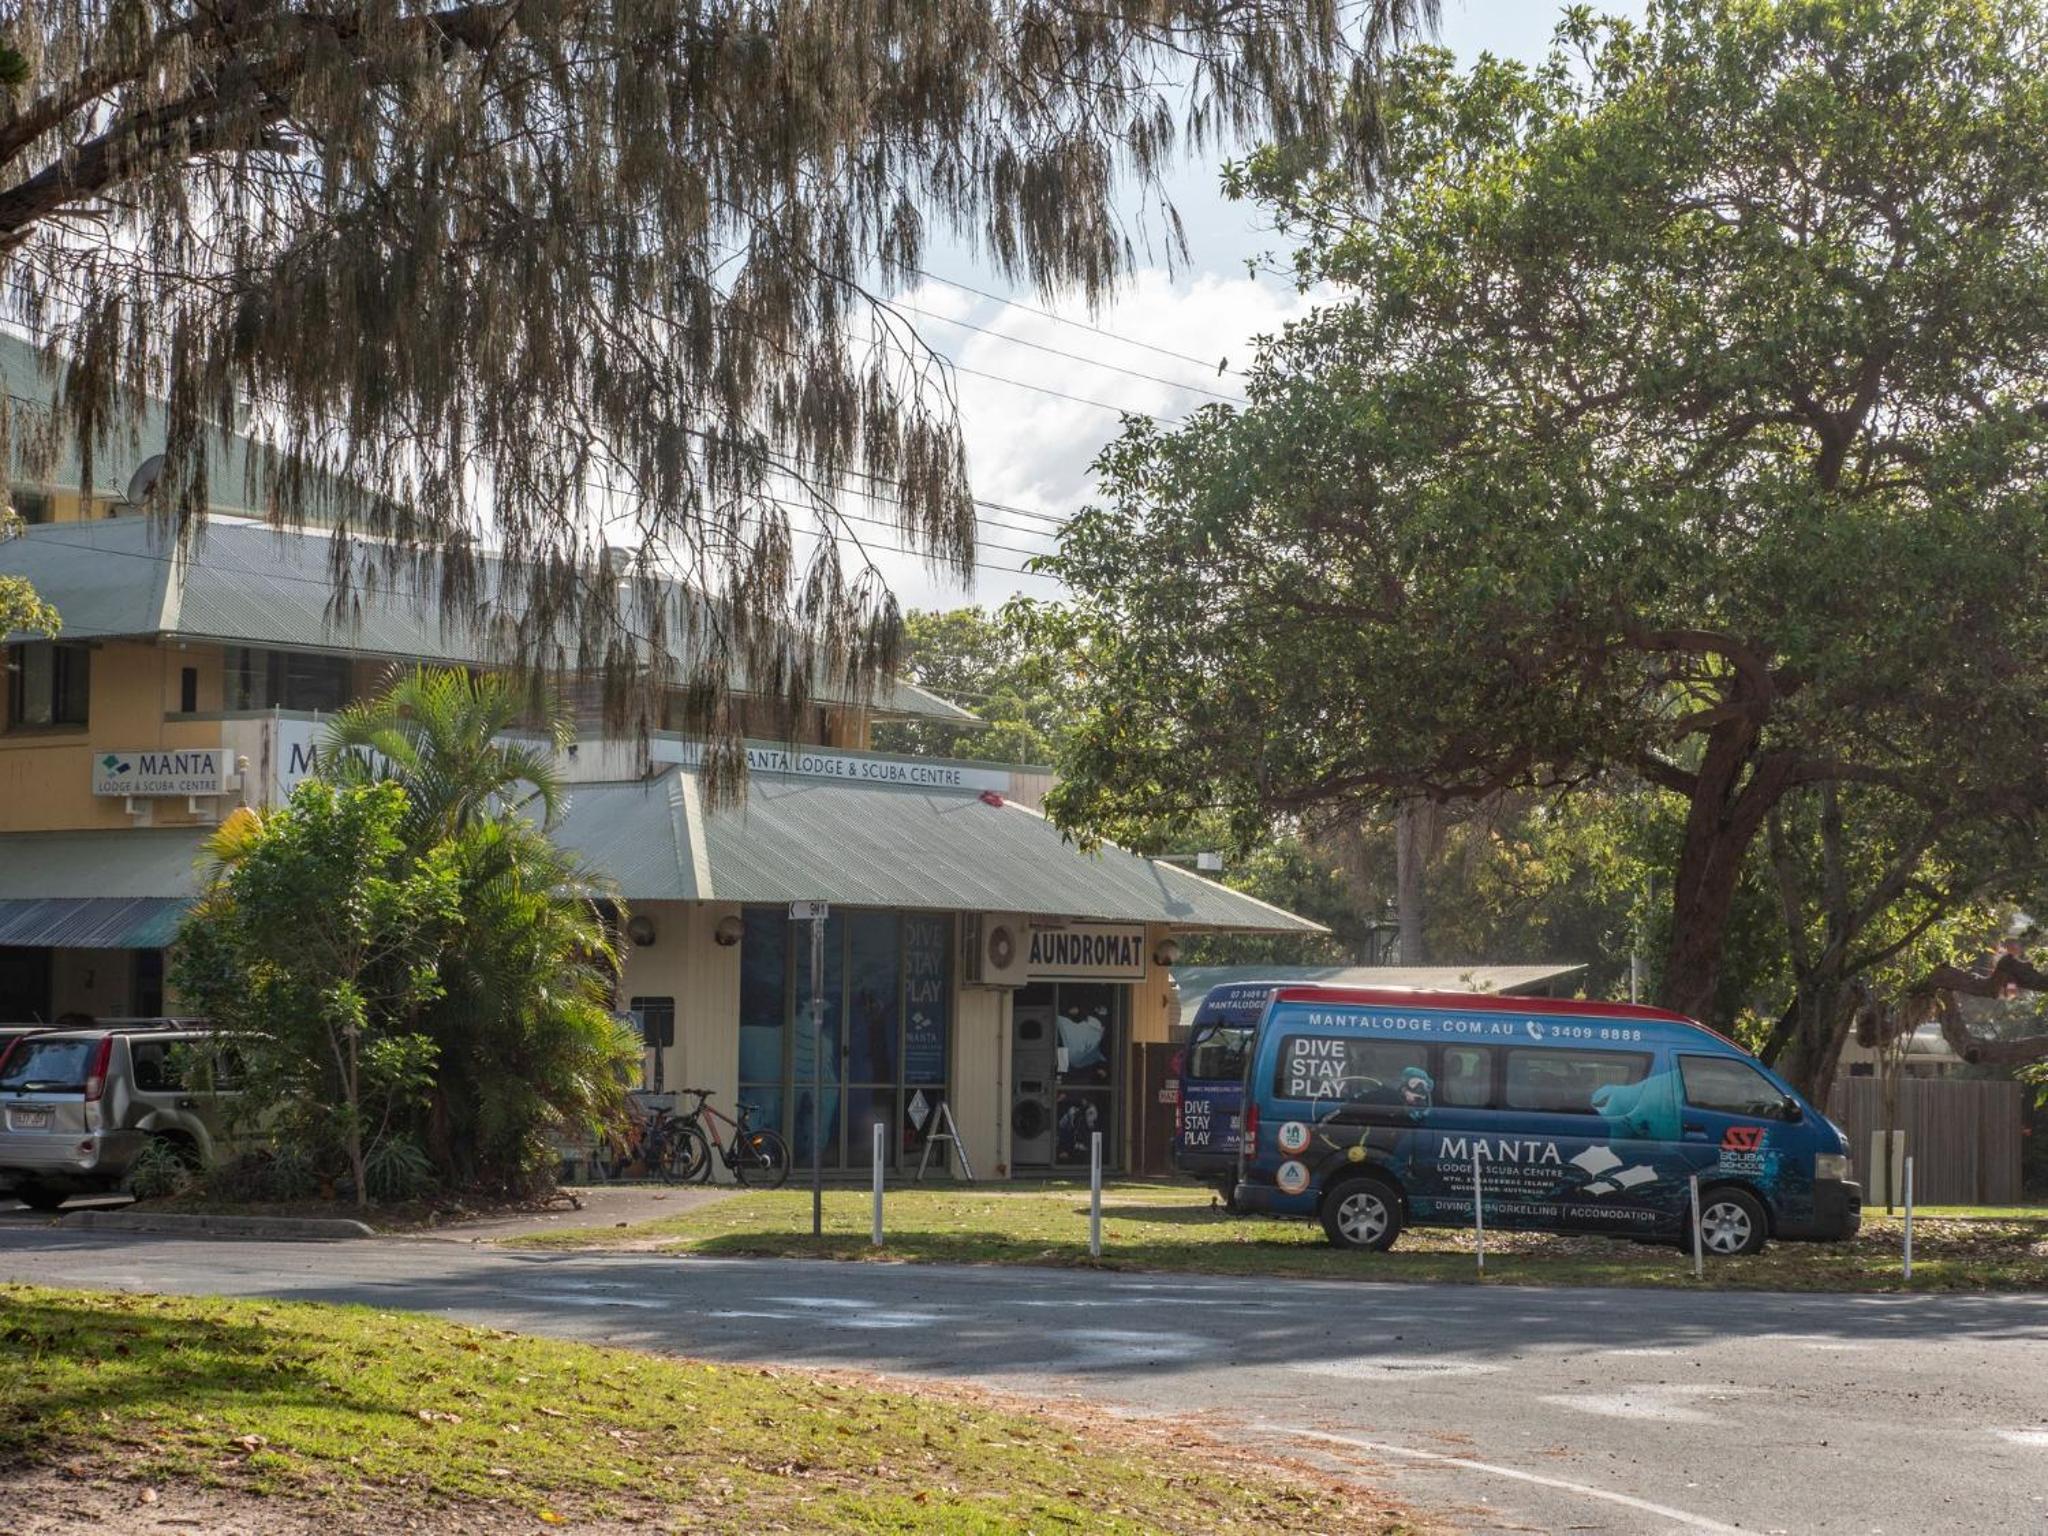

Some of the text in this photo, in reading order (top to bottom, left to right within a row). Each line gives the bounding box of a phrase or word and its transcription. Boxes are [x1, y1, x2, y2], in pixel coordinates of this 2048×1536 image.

[139, 753, 216, 775] MANTA
[748, 751, 961, 785] ANTA LODGE & SCUBA CENTRE
[98, 780, 131, 793] LODGE
[143, 780, 175, 792] SCUBA
[179, 780, 217, 791] CENTRE
[1029, 932, 1143, 967] AUNDROMAT
[905, 979, 942, 1003] PLAY
[1208, 1000, 1267, 1010] MANTALODGE
[1309, 1013, 1642, 1042] MANTALODGE.COM.AU 3409 8888
[1295, 1039, 1345, 1058] DIVE
[1292, 1059, 1347, 1079] STAY
[1290, 1079, 1347, 1099] PLAY
[1184, 1100, 1211, 1114] DIVE
[1184, 1115, 1211, 1130] STAY
[1184, 1131, 1211, 1145] PLAY
[1438, 1136, 1562, 1165] MANTA
[1720, 1151, 1765, 1162] SCUBA
[1437, 1161, 1471, 1173] LODGE
[1486, 1165, 1520, 1175] SCUBA
[1523, 1167, 1564, 1178] CENTRE
[1435, 1200, 1656, 1221] DIVING SNORKELLING ACCOMODATION
